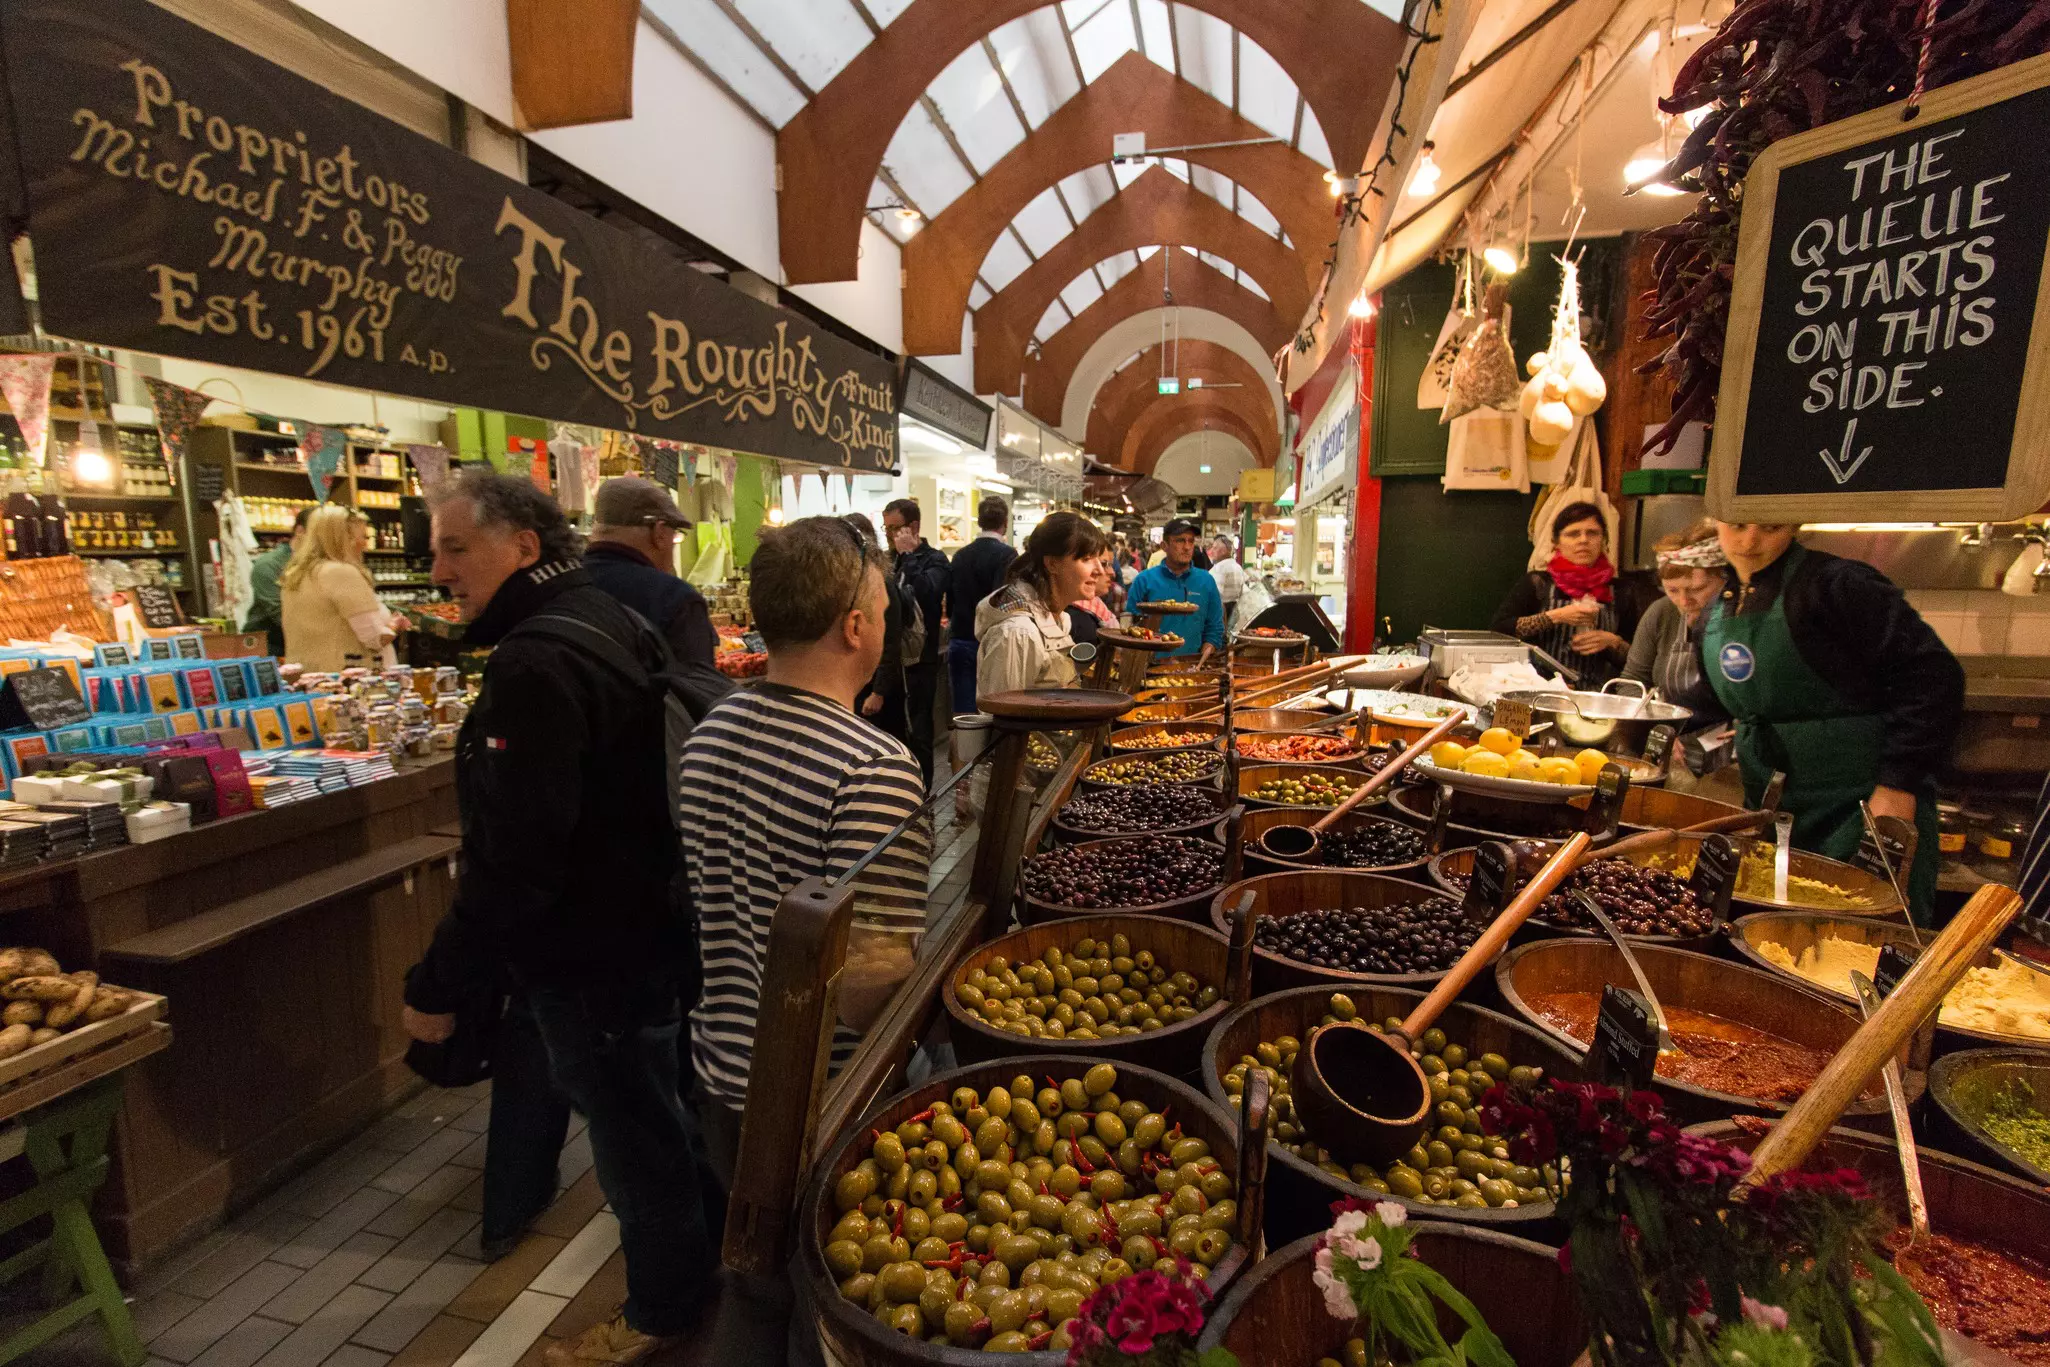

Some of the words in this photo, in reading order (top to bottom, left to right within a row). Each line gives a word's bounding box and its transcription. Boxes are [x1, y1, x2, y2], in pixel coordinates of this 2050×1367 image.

[120, 58, 430, 224] Proprietors
[1844, 128, 1965, 201] THE
[342, 209, 376, 254] &
[382, 217, 462, 302] Peggy
[1791, 172, 2011, 267] QUEUE
[209, 217, 401, 330] Murphy
[1794, 235, 1996, 317] STARTS
[146, 263, 289, 344] Est.
[297, 306, 385, 377] 1961
[400, 344, 456, 374] A.D.
[494, 196, 634, 384] The
[647, 311, 846, 434] Roughty
[1787, 317, 1858, 364] ON
[842, 369, 895, 416] Fruit
[849, 406, 895, 469] King
[1498, 702, 1530, 716] ORGANIC
[1499, 714, 1526, 726] LEMON
[1618, 1032, 1640, 1059] Stuffed
